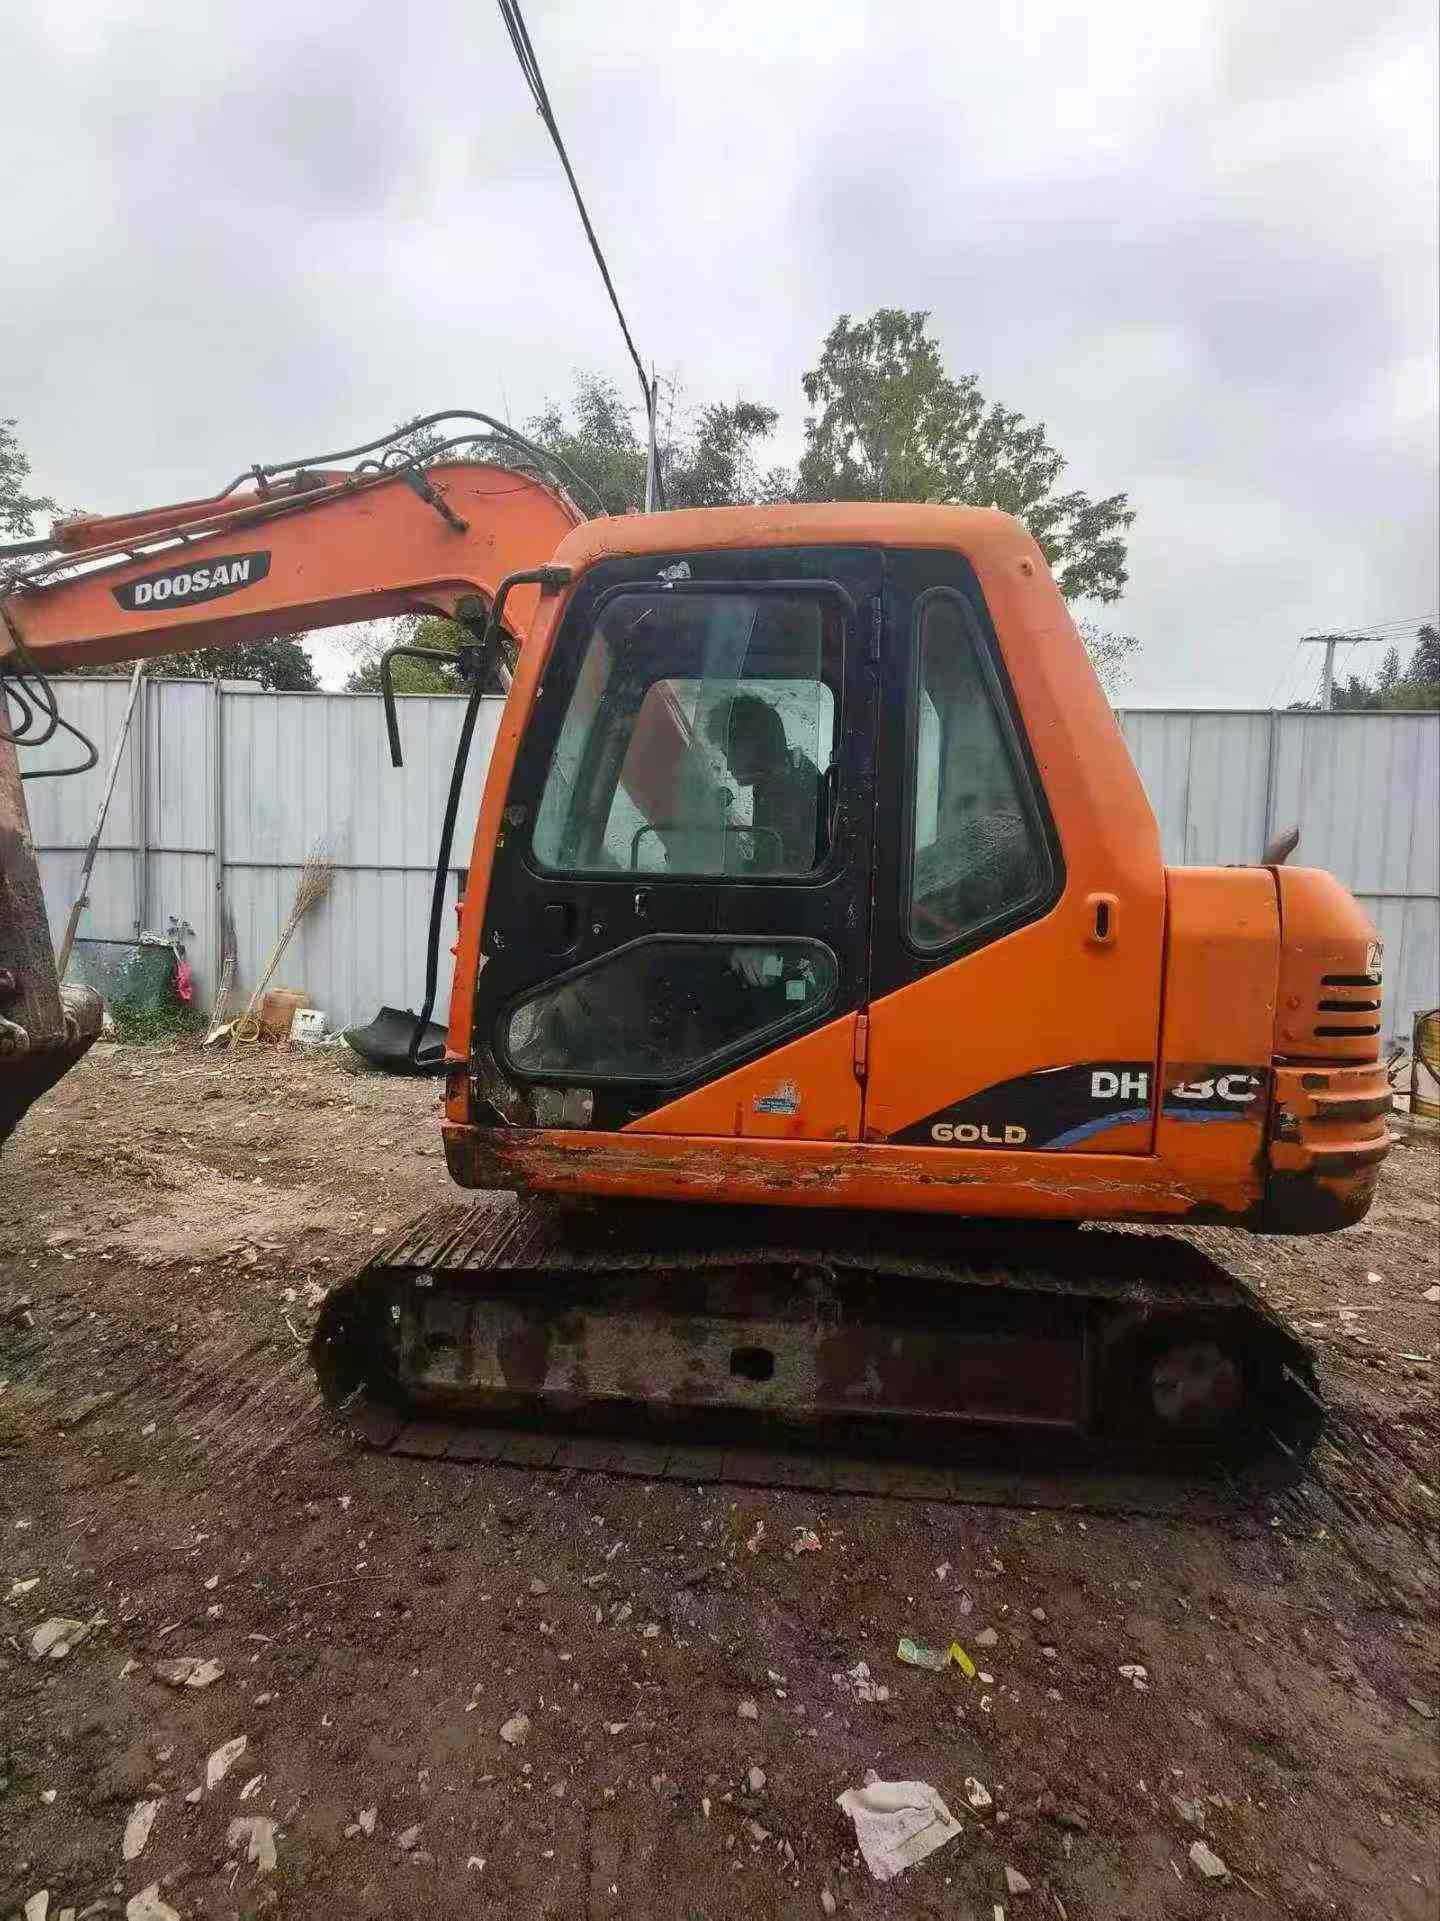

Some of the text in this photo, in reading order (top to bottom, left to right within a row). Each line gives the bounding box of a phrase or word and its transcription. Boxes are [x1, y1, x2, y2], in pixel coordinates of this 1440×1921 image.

[134, 559, 250, 605] DOOSAN
[1091, 1071, 1148, 1099] DH
[931, 1122, 1027, 1144] GOLD
